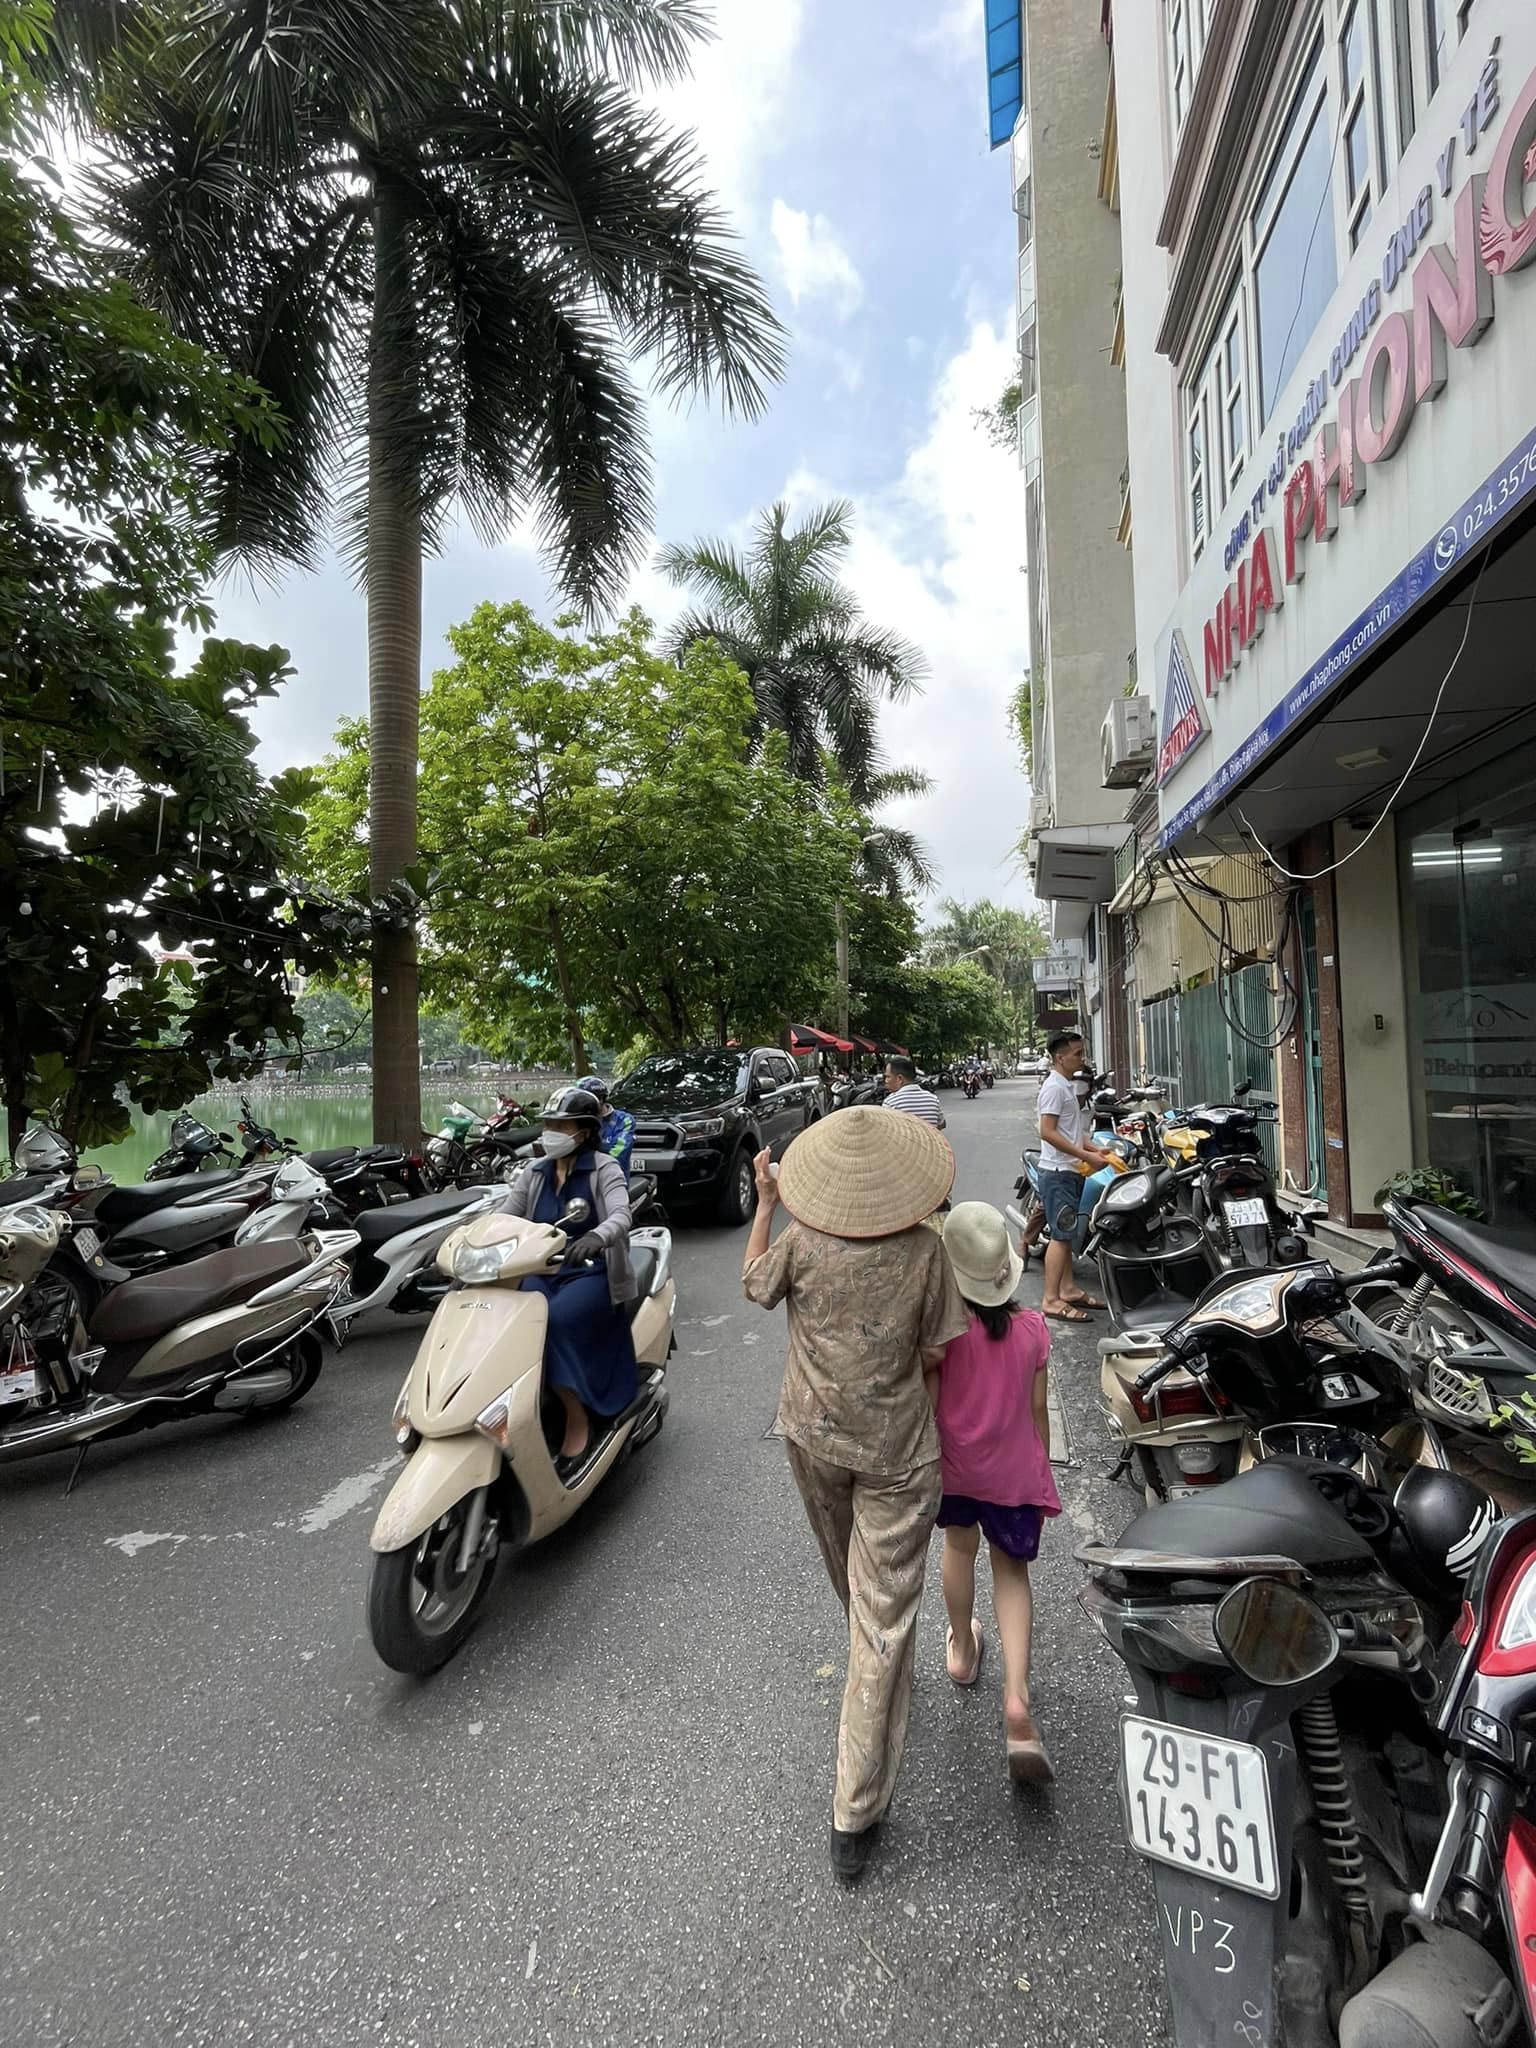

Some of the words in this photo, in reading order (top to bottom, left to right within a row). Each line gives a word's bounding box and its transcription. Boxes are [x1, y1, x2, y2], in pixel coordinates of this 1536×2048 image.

[1251, 478, 1266, 525] TY
[1329, 278, 1382, 387] CUNG
[1435, 136, 1457, 198] Y
[1459, 35, 1501, 157] TẾ
[1203, 527, 1284, 698] NHA
[1283, 62, 1536, 586] PHONG
[1289, 602, 1391, 715] www.nhaphong.com.vn
[1141, 1729, 1242, 1810] 29-F1
[1137, 1789, 1264, 1884] 143.61
